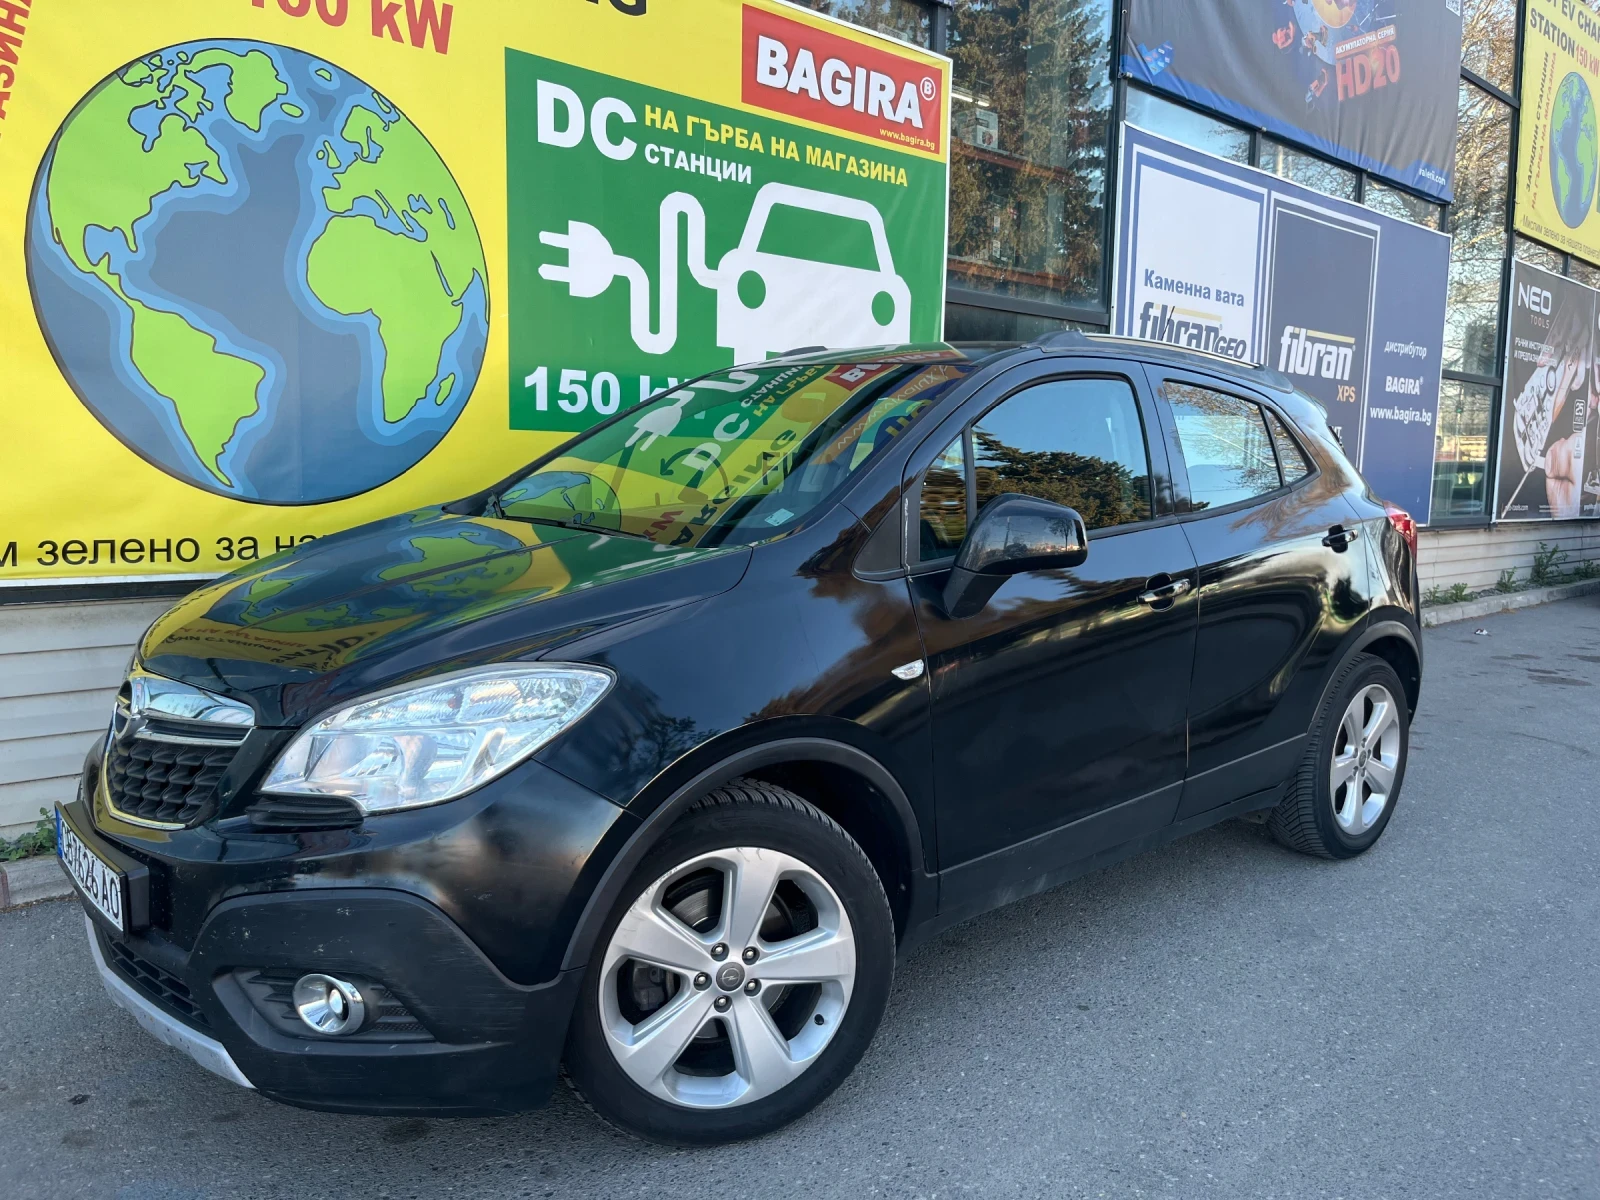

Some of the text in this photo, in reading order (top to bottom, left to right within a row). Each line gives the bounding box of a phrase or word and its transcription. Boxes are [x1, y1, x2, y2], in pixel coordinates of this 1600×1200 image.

[371, 0, 453, 55] kW
[1377, 27, 1395, 40] СЕРИЯ
[1530, 7, 1575, 58] STATION
[1576, 44, 1588, 69] 150
[756, 34, 924, 129] BAGIRA
[1335, 44, 1400, 102] HD20
[536, 79, 638, 161] DC
[879, 128, 936, 150] www.bagira.bg
[644, 143, 752, 185] СТАНЦИИ
[645, 104, 908, 187] НА ГЪРБА НА МАГАЗИНА
[1144, 268, 1244, 307] Каменна вата
[1517, 281, 1552, 316] NEO
[1530, 314, 1550, 329] TOOLS
[1278, 325, 1354, 381] fibran
[1384, 341, 1427, 360] дистрибутор
[524, 366, 620, 415] 150
[1336, 385, 1356, 402] XPS
[1385, 375, 1420, 396] BAGIRA
[1369, 405, 1432, 427] www.bagira.bg
[37, 538, 200, 566] зелено
[215, 536, 260, 561] за
